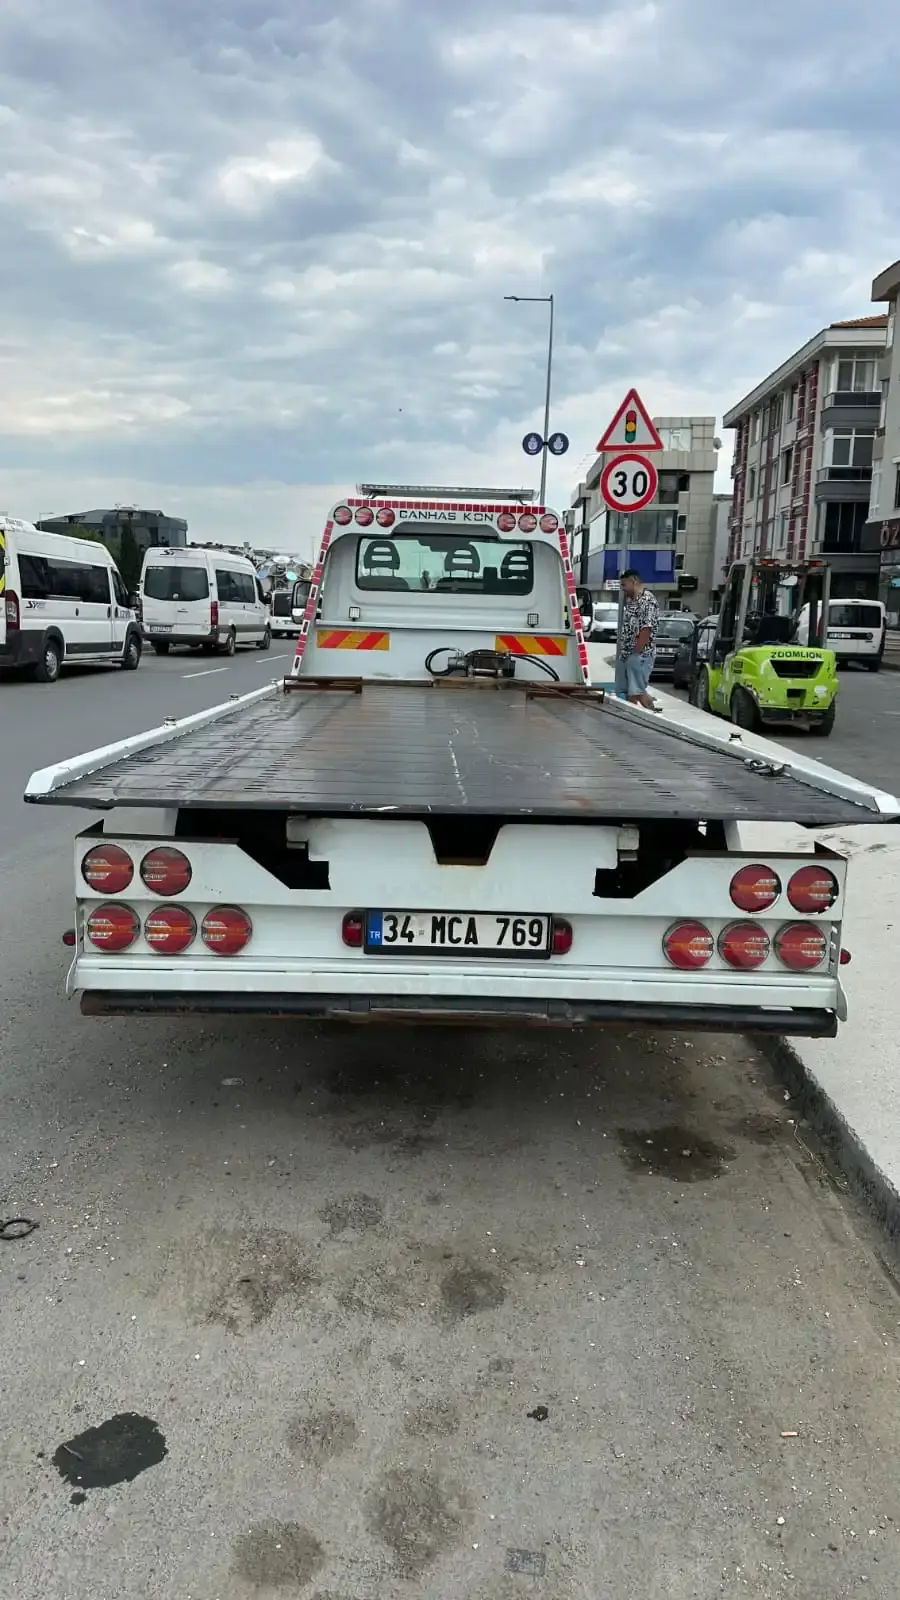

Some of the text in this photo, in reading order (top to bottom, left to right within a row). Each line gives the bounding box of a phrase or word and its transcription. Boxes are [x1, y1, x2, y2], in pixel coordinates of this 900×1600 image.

[613, 470, 648, 498] 30
[399, 510, 457, 521] CANHAS
[771, 650, 823, 660] ZOOMLION
[369, 915, 543, 947] TR 34 MCA 769
